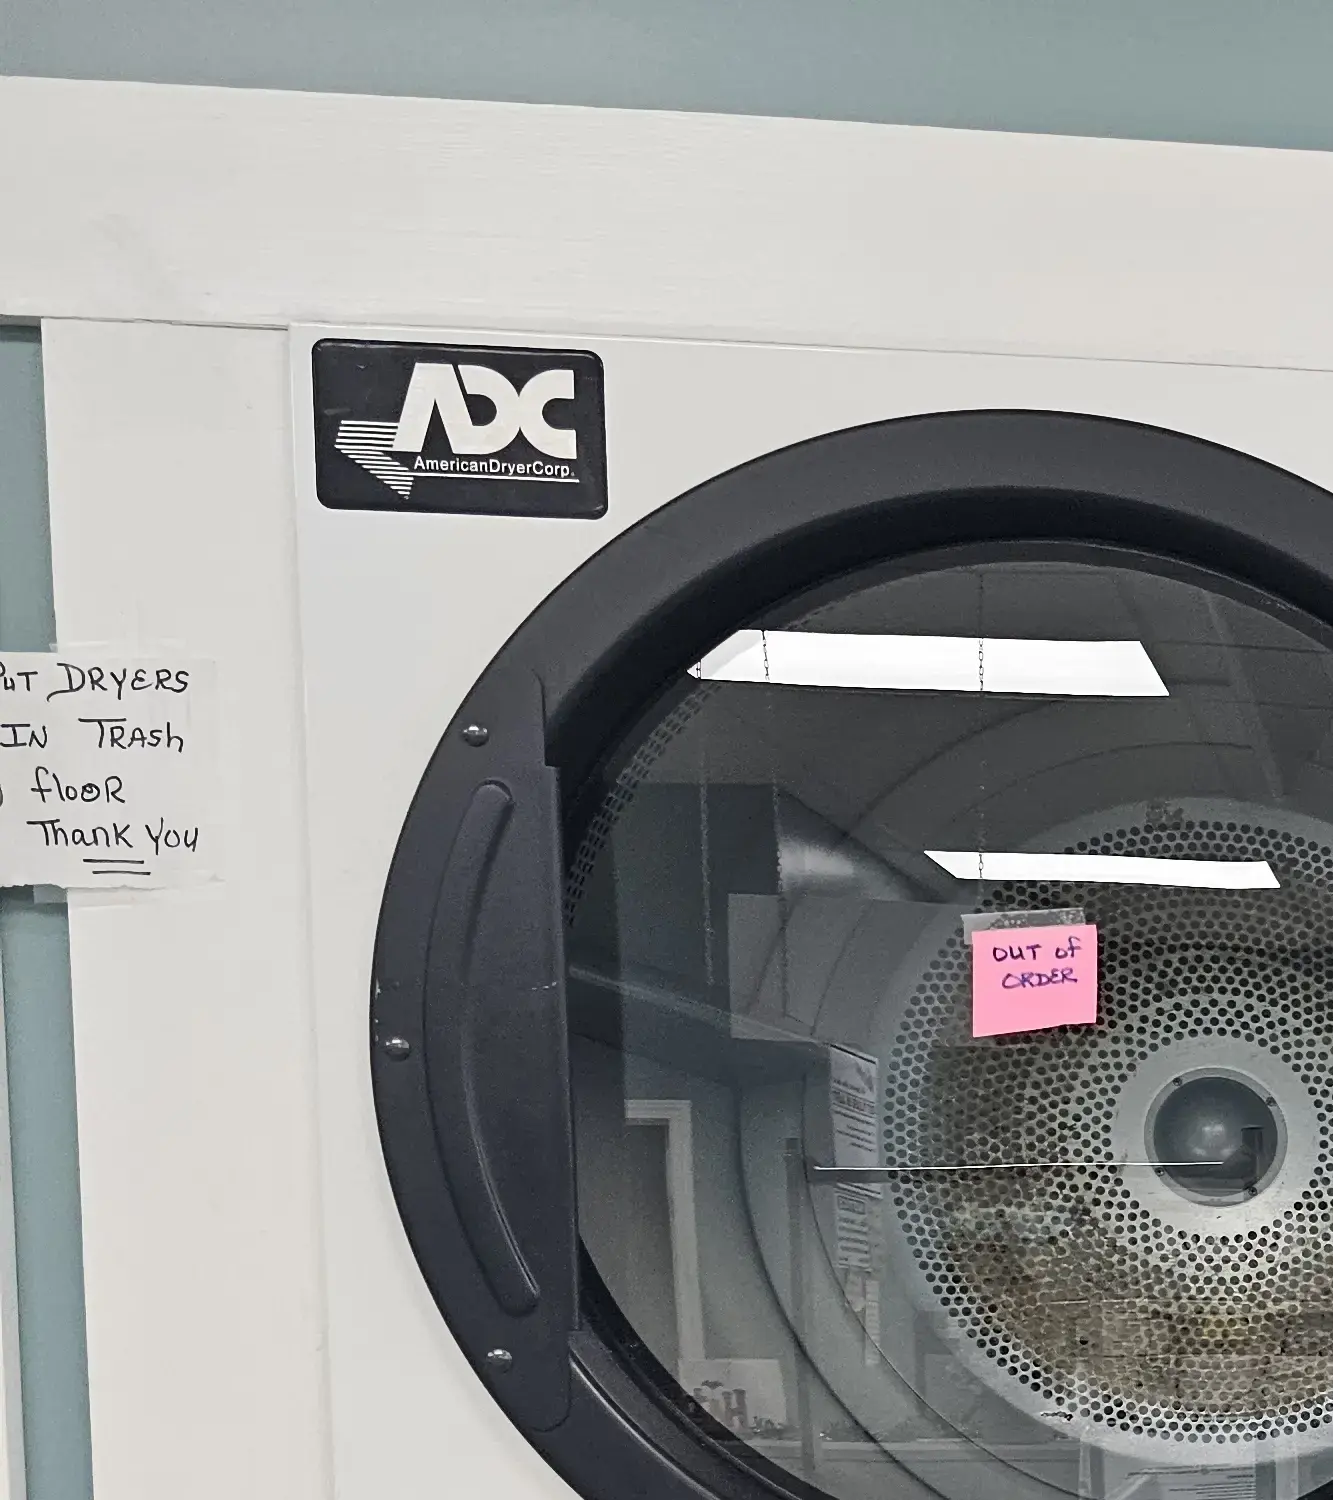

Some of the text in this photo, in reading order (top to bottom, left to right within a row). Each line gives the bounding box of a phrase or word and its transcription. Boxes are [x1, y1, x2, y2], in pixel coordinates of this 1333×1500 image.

[392, 363, 578, 460] ADC
[46, 662, 190, 702] DRYERS
[0, 724, 48, 749] IN
[992, 943, 1043, 962] OUT
[1001, 966, 1079, 990] ORDER
